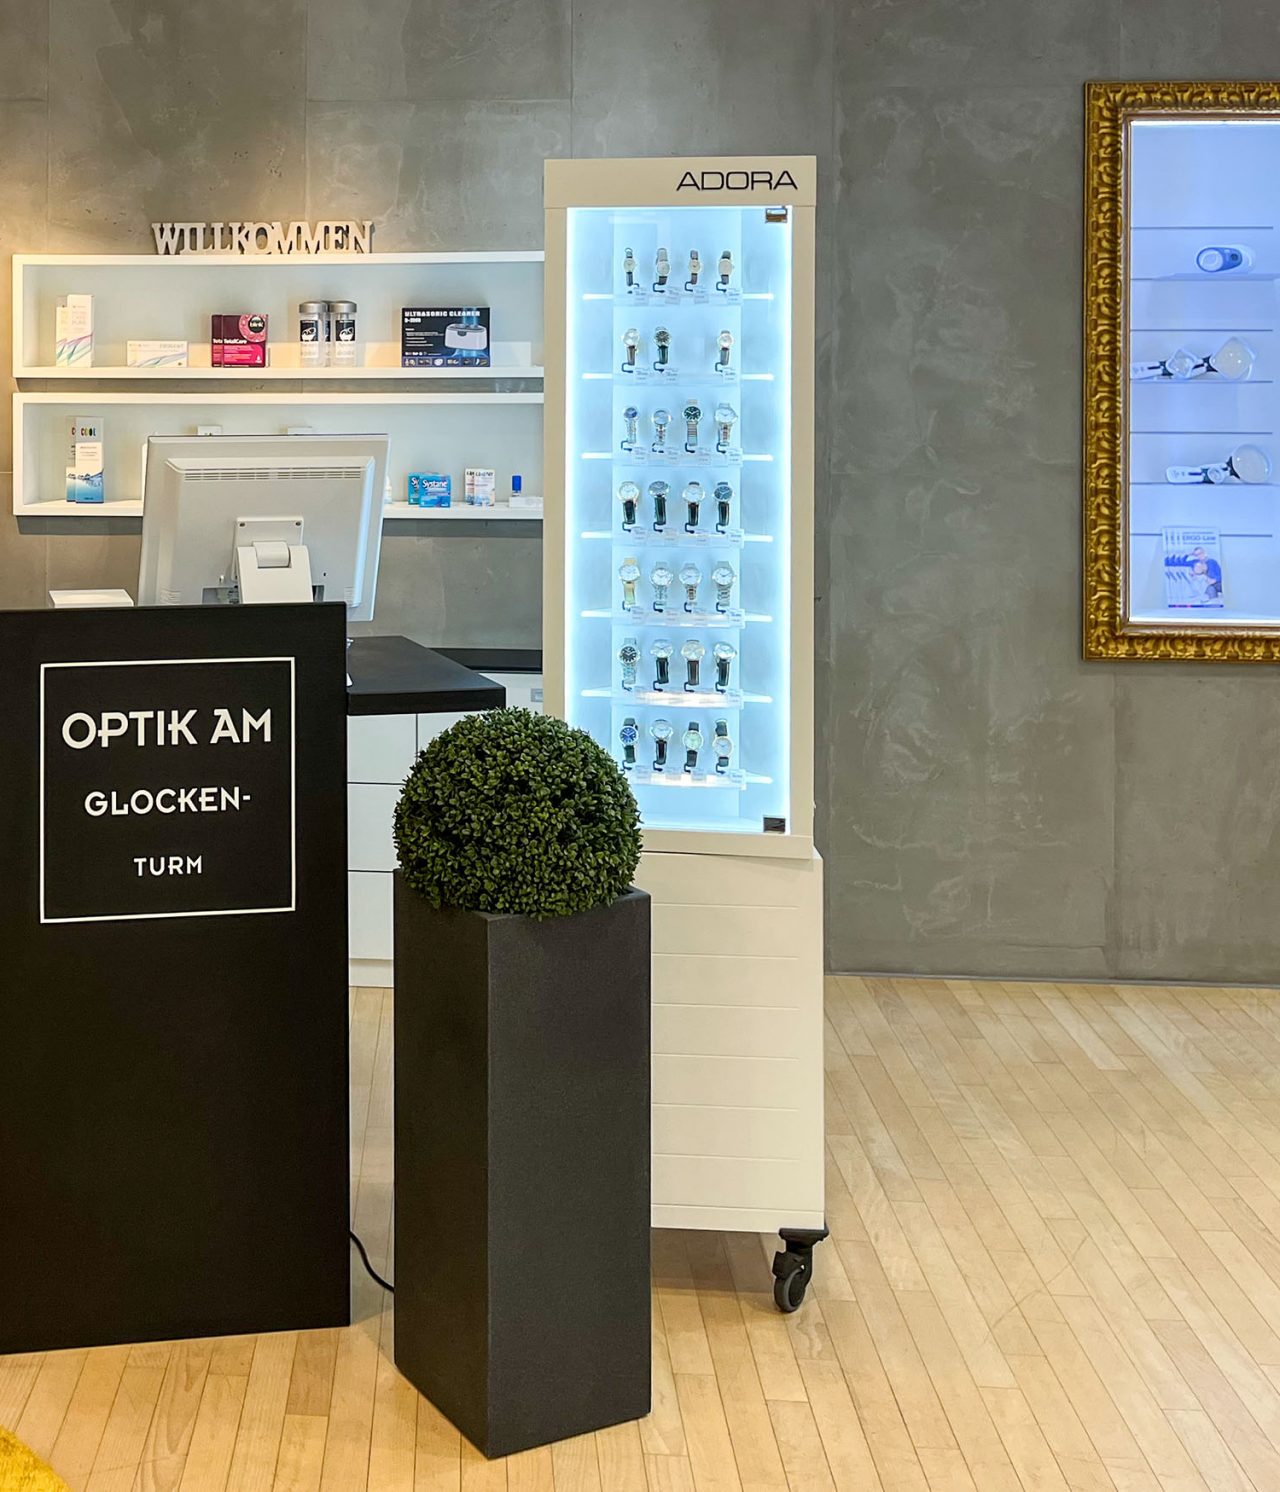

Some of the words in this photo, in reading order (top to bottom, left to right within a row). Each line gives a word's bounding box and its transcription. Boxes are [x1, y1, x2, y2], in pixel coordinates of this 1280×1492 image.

[676, 170, 798, 191] ADORA
[151, 221, 374, 255] WILLKOMMEN
[62, 709, 198, 749] OPTIK
[210, 708, 271, 744] AM
[84, 786, 251, 817] GLOCKEN-
[134, 855, 203, 877] TURM
